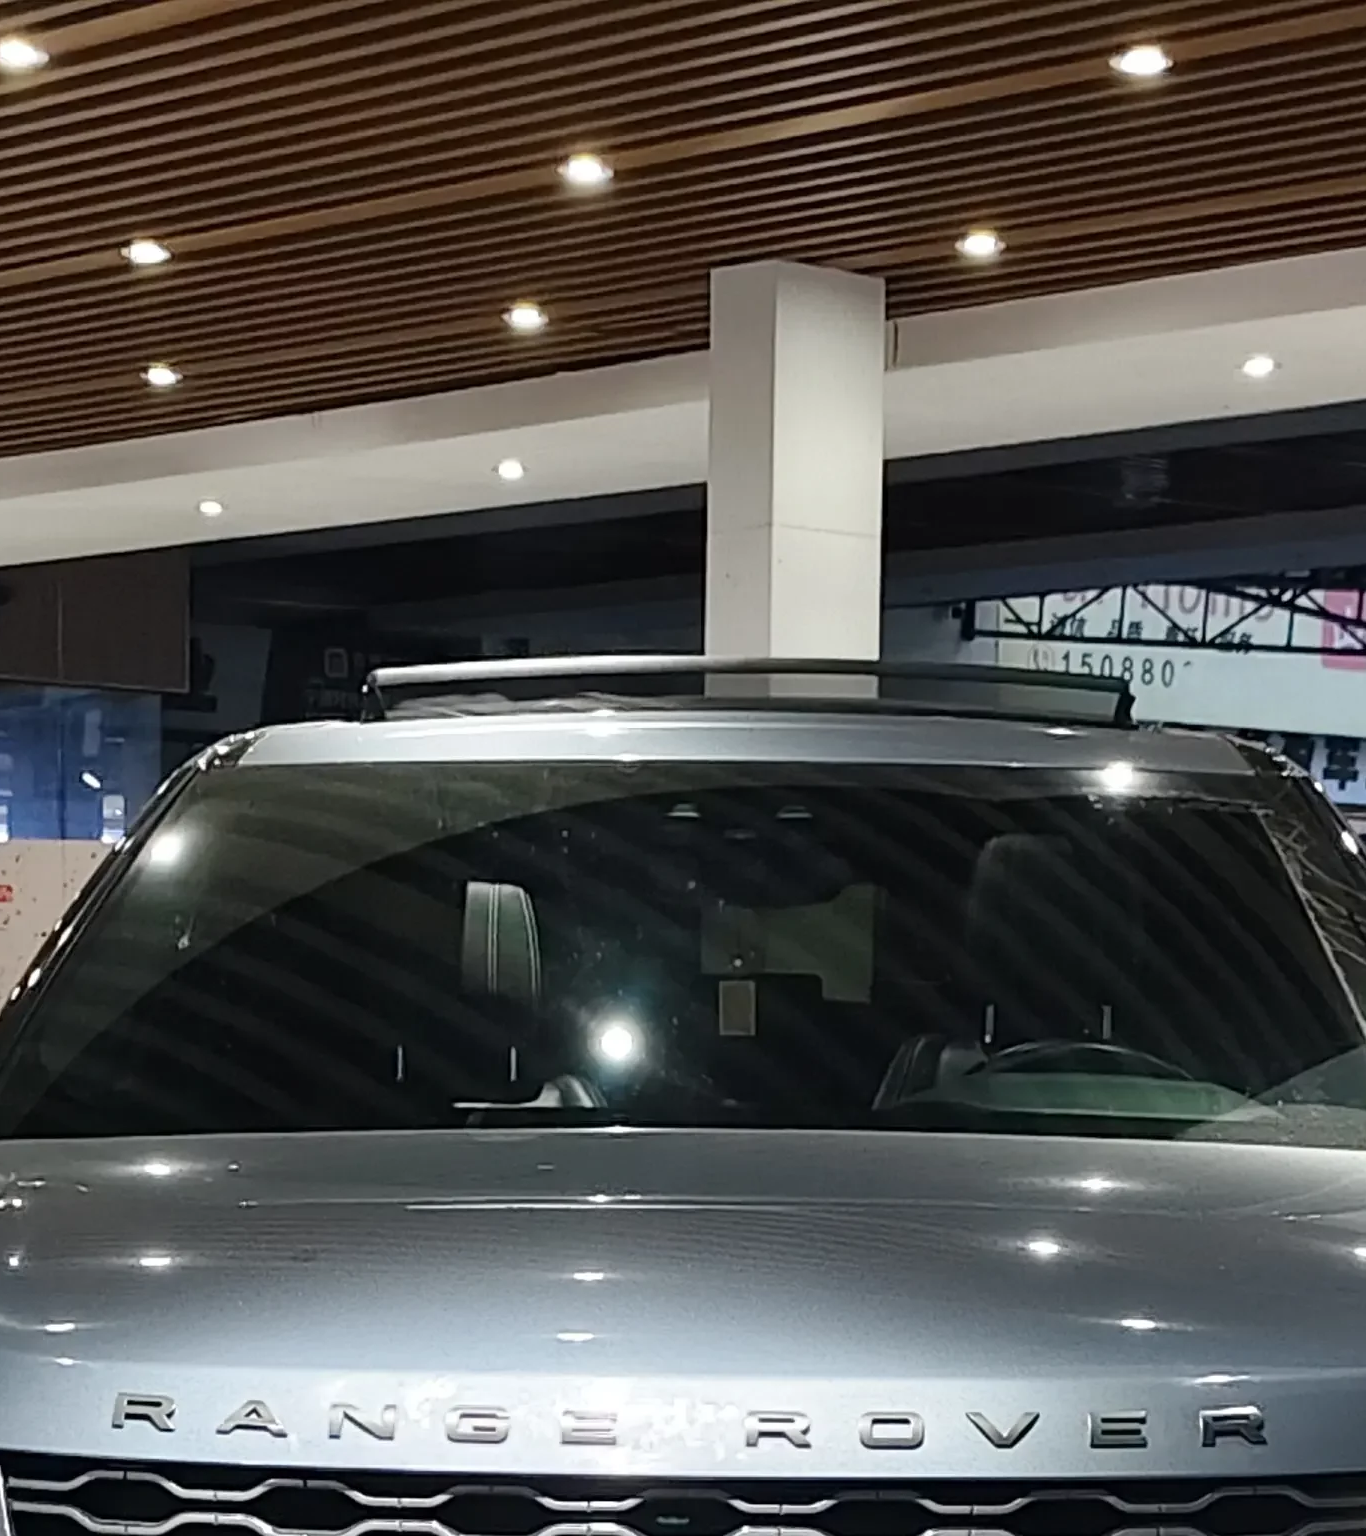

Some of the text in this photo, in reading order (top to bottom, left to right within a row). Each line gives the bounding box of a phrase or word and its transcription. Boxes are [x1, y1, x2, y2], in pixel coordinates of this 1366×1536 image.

[1061, 649, 1193, 688] 150880
[111, 1390, 1270, 1449] RANGE ROVER
